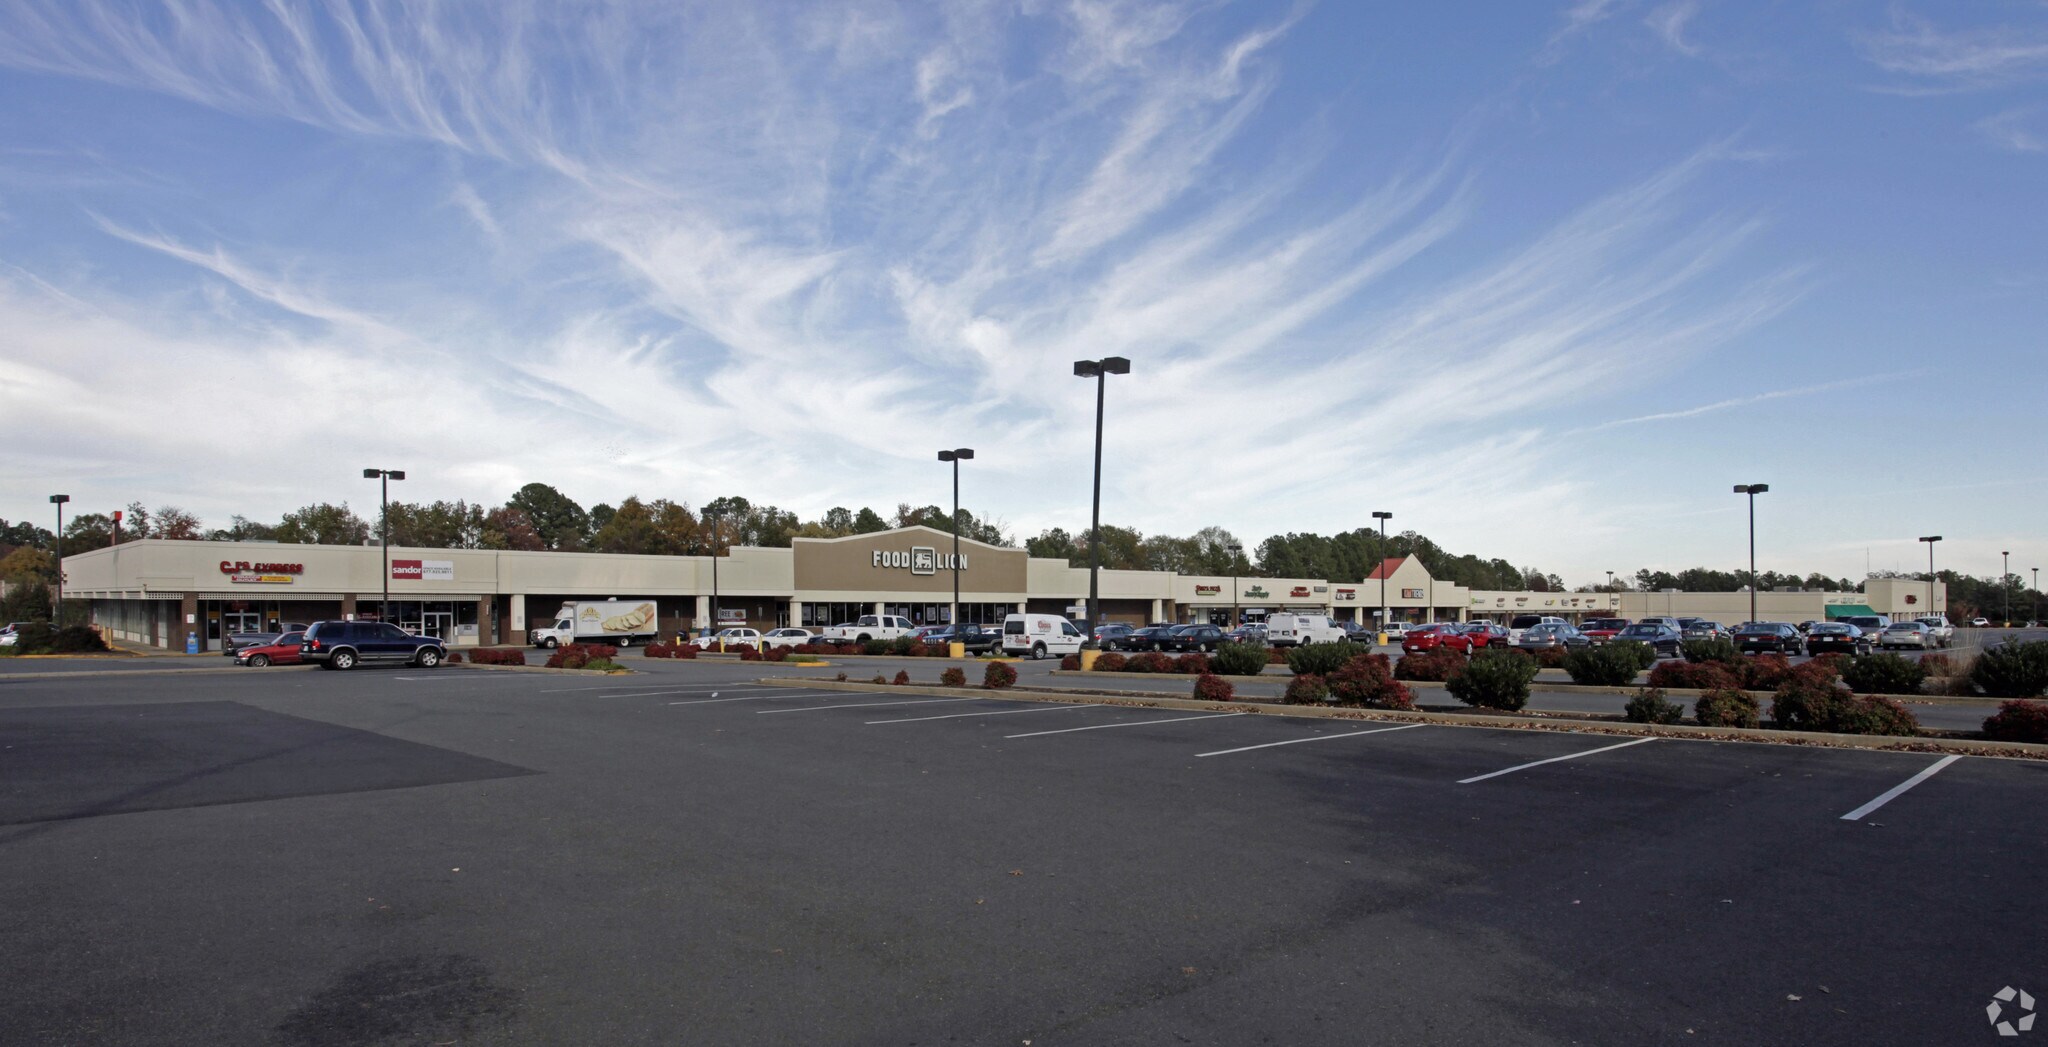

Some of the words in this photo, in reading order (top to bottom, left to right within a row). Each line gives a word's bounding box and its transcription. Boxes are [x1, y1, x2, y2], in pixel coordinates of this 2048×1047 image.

[873, 550, 910, 568] FOOD
[936, 553, 968, 570] LION
[253, 563, 304, 574] EXPRESS
[393, 566, 421, 574] sandor
